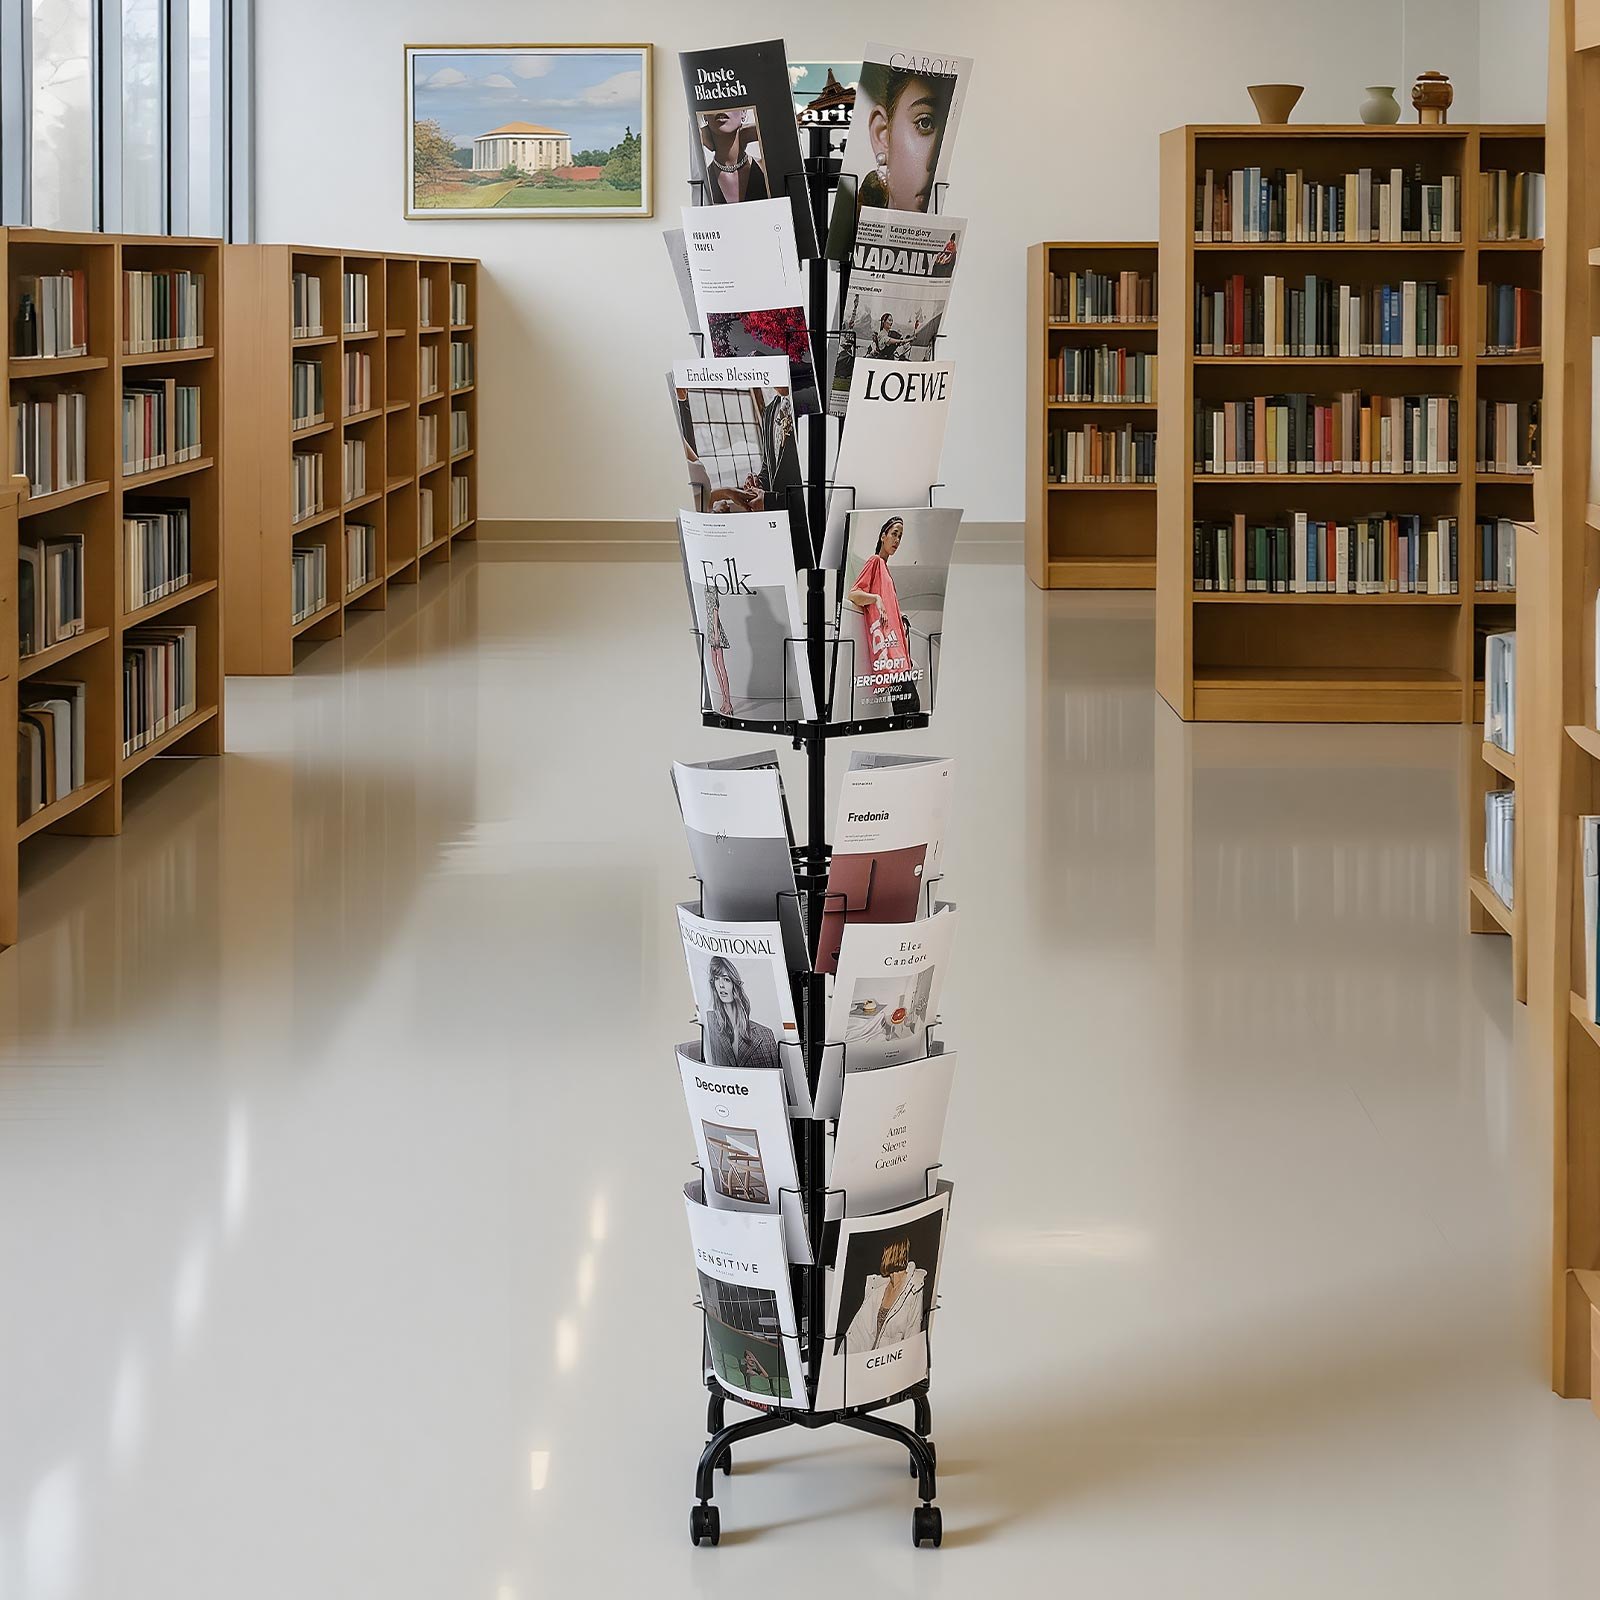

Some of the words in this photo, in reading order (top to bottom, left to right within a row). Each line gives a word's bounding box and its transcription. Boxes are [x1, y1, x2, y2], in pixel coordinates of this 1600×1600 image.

[889, 52, 958, 79] CAROLE
[697, 67, 735, 84] Duste
[694, 80, 748, 101] Blackish
[686, 367, 724, 382] Endless
[726, 366, 770, 385] Blessing
[864, 370, 949, 402] LOEWE
[872, 657, 906, 672] SPORT
[872, 687, 885, 695] APP
[847, 810, 890, 822] Fredonia
[695, 1076, 749, 1096] Decorate
[886, 1125, 907, 1137] Anna
[881, 1139, 907, 1154] Sleeve
[875, 1154, 908, 1170] Creative
[697, 1248, 759, 1274] SENSITIVE
[866, 1349, 903, 1369] CELINE
